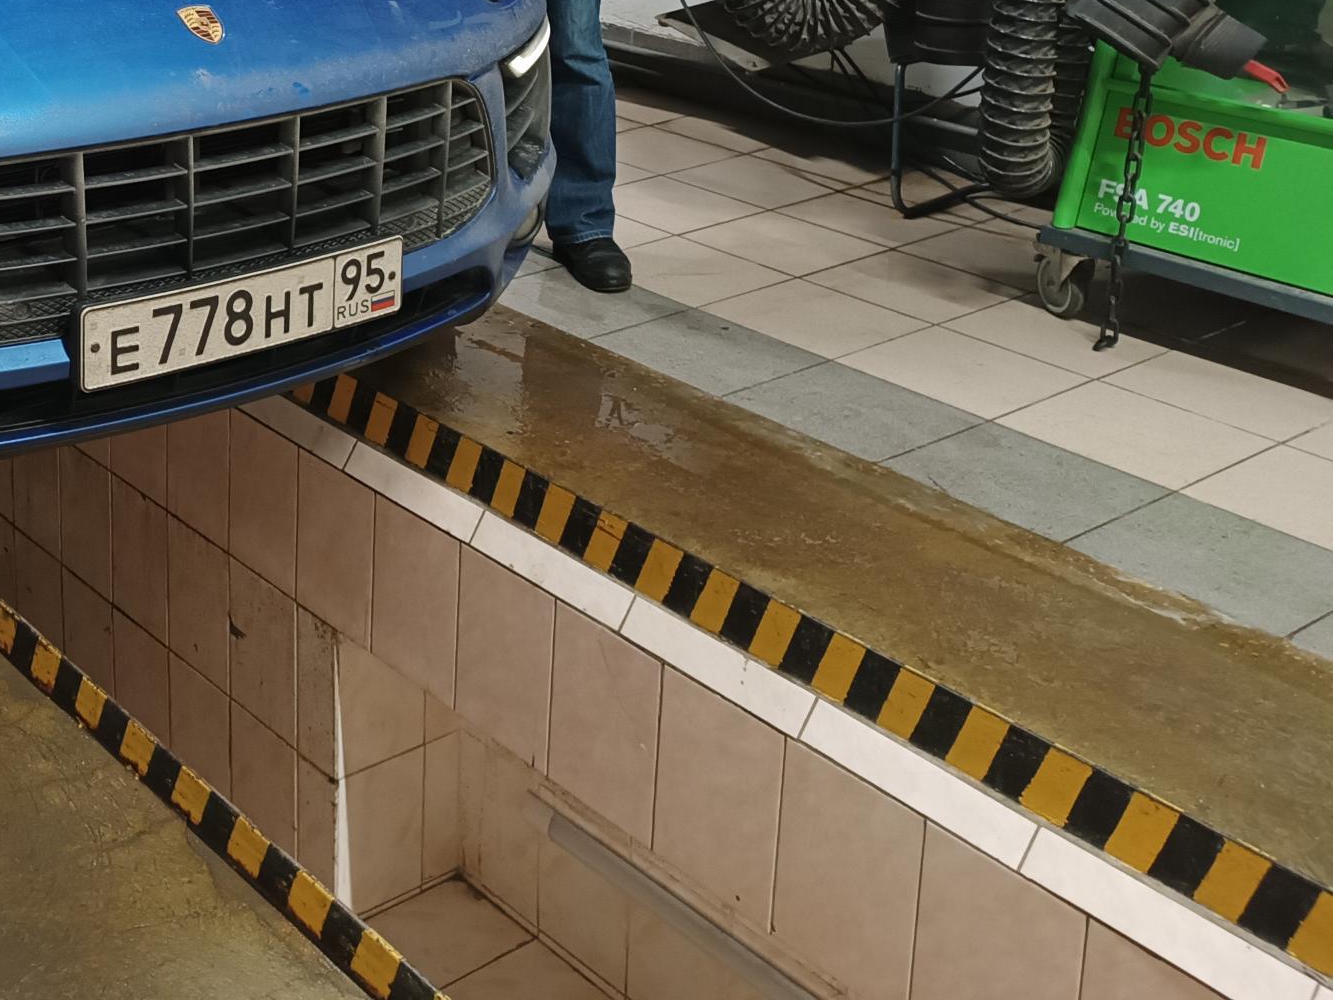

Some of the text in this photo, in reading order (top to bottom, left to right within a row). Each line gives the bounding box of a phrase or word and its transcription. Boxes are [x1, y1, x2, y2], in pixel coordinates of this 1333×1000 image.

[1115, 107, 1267, 170] BOSCH
[1156, 193, 1201, 222] 740
[1150, 217, 1166, 233] by
[1168, 221, 1240, 252] ESI[tronic]
[341, 250, 385, 302] 95
[336, 299, 370, 320] RUS
